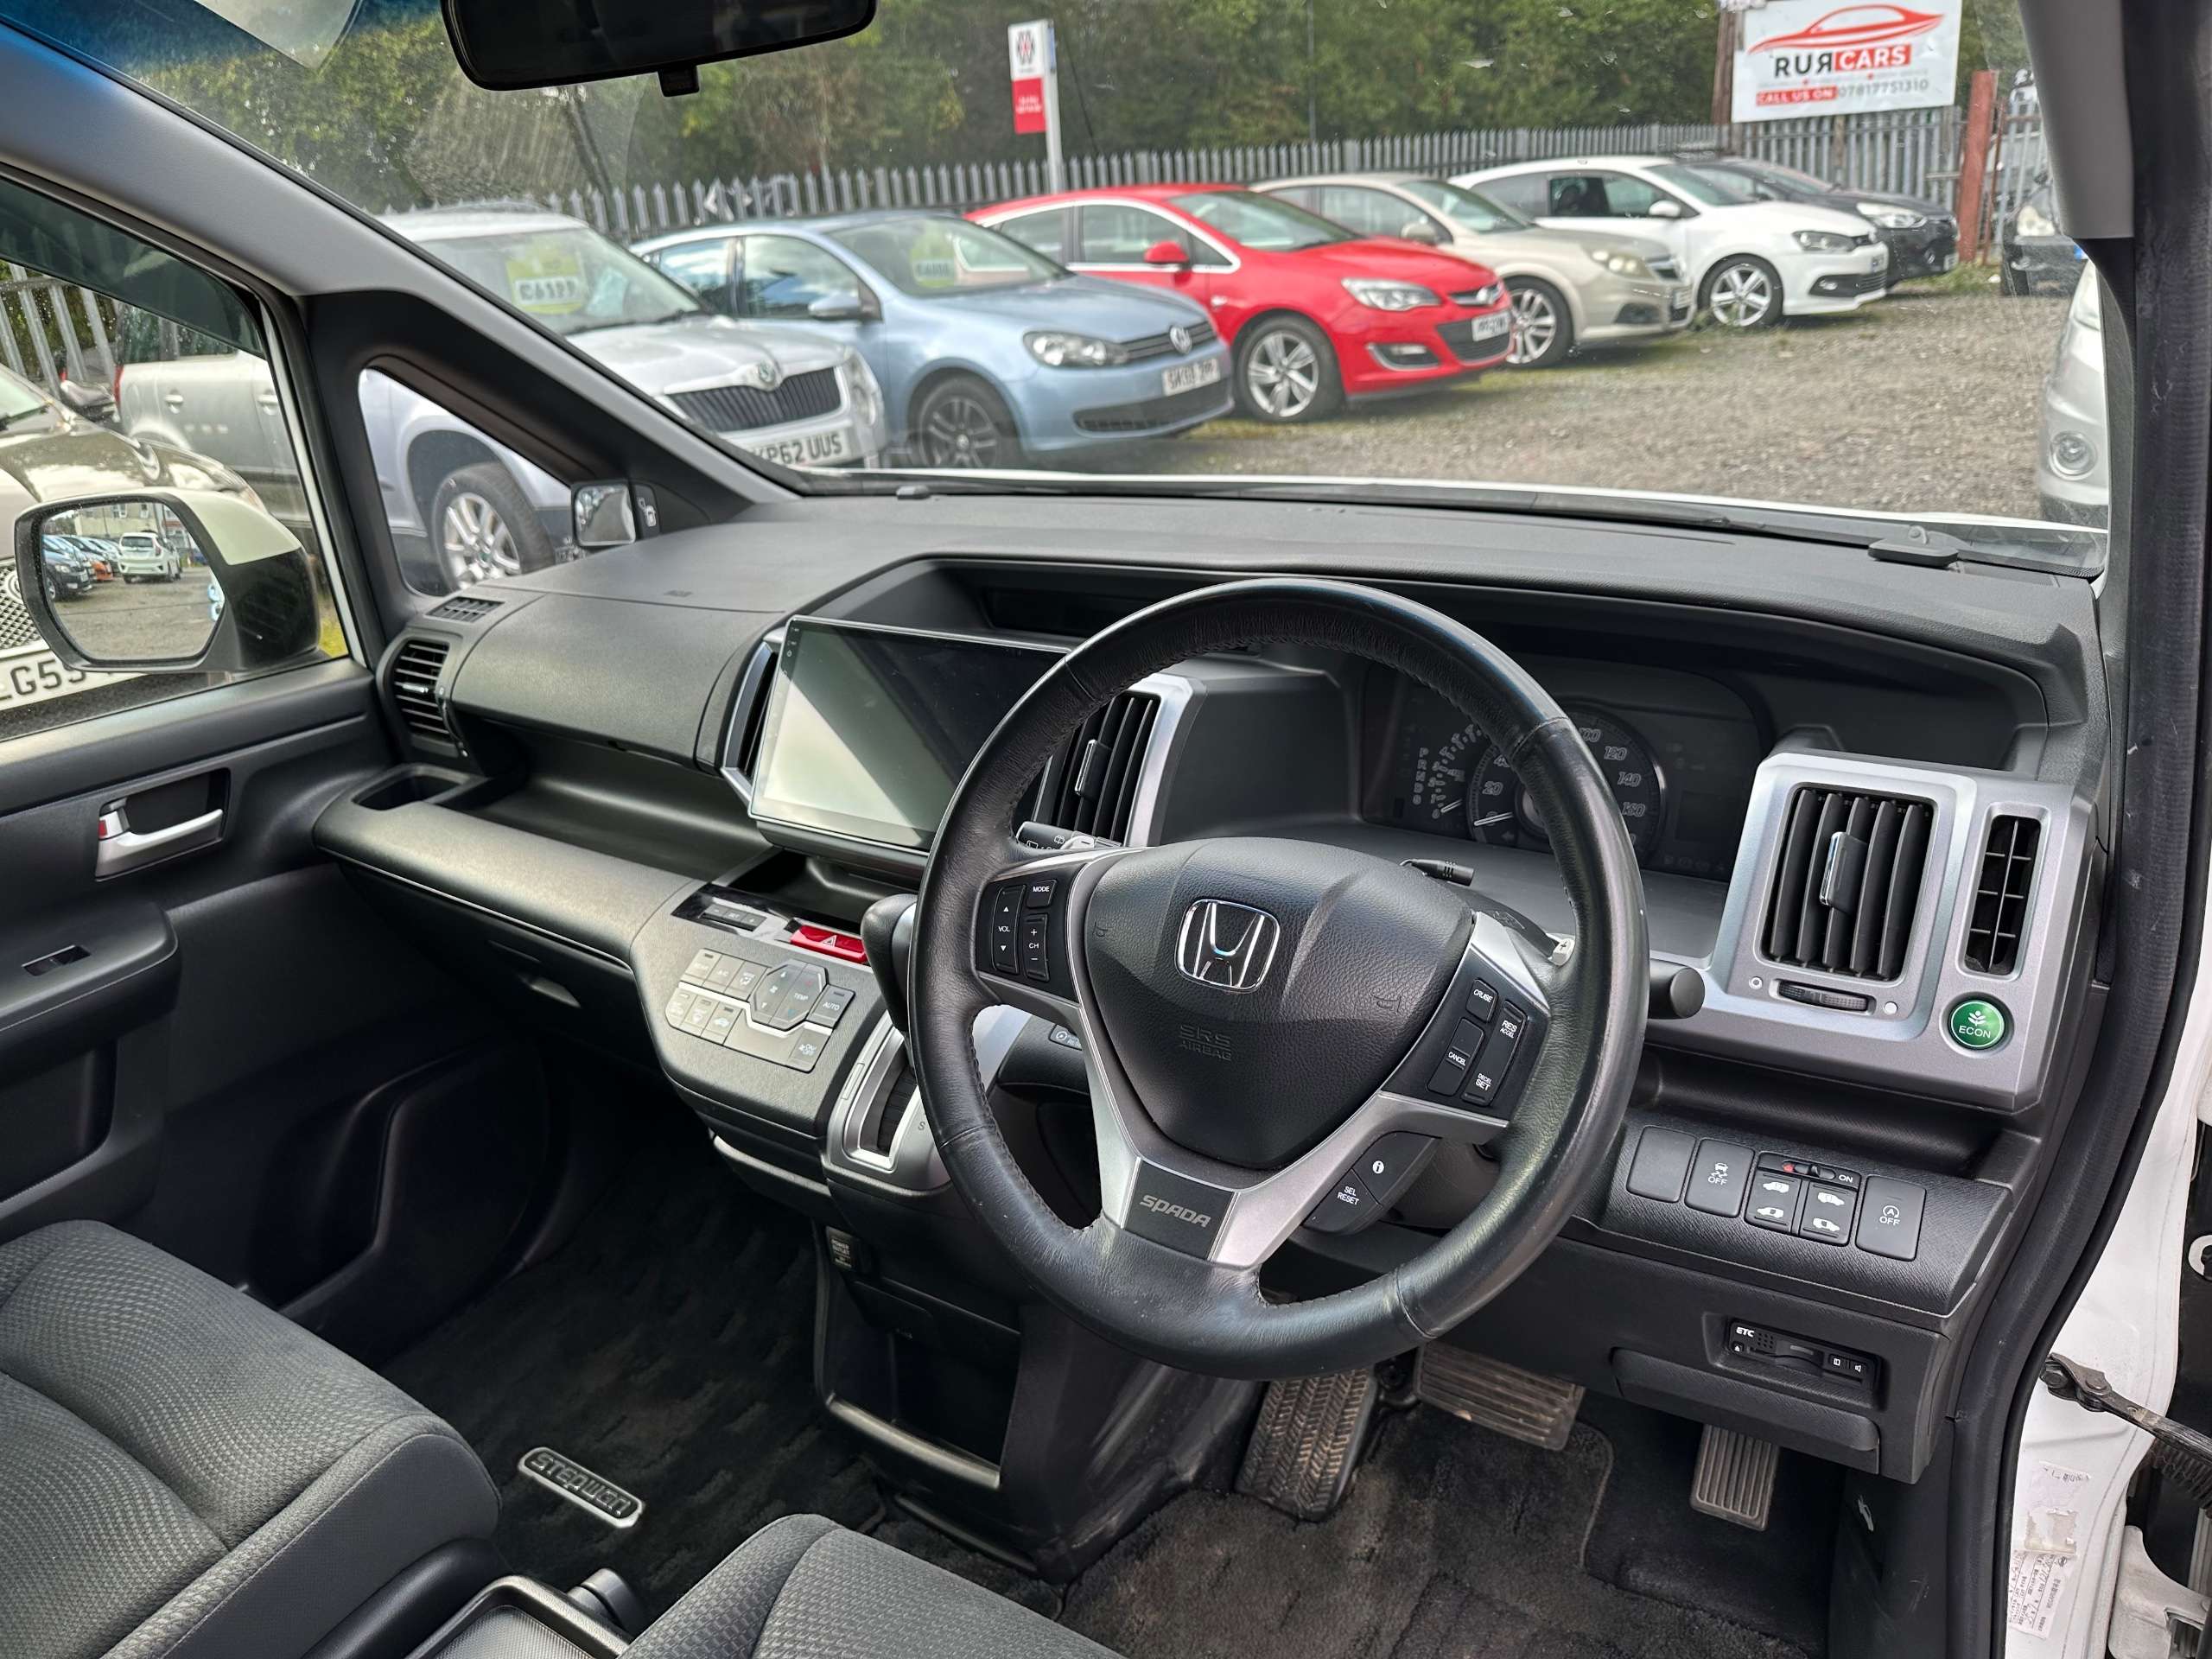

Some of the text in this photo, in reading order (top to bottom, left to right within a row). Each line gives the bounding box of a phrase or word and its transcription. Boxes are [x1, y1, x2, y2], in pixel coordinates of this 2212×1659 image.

[1758, 91, 1790, 105] CALL
[1791, 89, 1811, 101] US
[1813, 87, 1834, 100] ON
[807, 434, 842, 460] UUS
[1604, 745, 1628, 761] 120
[1618, 772, 1641, 787] 140
[1482, 781, 1503, 795] 20
[1622, 801, 1646, 817] 160
[1473, 988, 1493, 1002] CRUISE
[823, 1001, 840, 1011] AUTO
[1499, 1027, 1514, 1039] ACCEL
[1502, 1020, 1517, 1033] RES
[1958, 1025, 1991, 1039] ECON
[1180, 1024, 1230, 1046] SRS
[1180, 1039, 1231, 1061] AIRBAG
[1447, 1051, 1466, 1066] CANCEL
[1475, 1078, 1491, 1091] SET
[1478, 1073, 1492, 1085] DECEL
[918, 1121, 926, 1131] S
[1707, 1176, 1727, 1185] OFF
[1838, 1173, 1853, 1183] ON
[1344, 1185, 1357, 1197] SEL
[1337, 1192, 1359, 1206] RESET
[1139, 1194, 1211, 1228] SPADA
[1879, 1216, 1901, 1226] OFF
[1736, 1325, 1755, 1338] ETC
